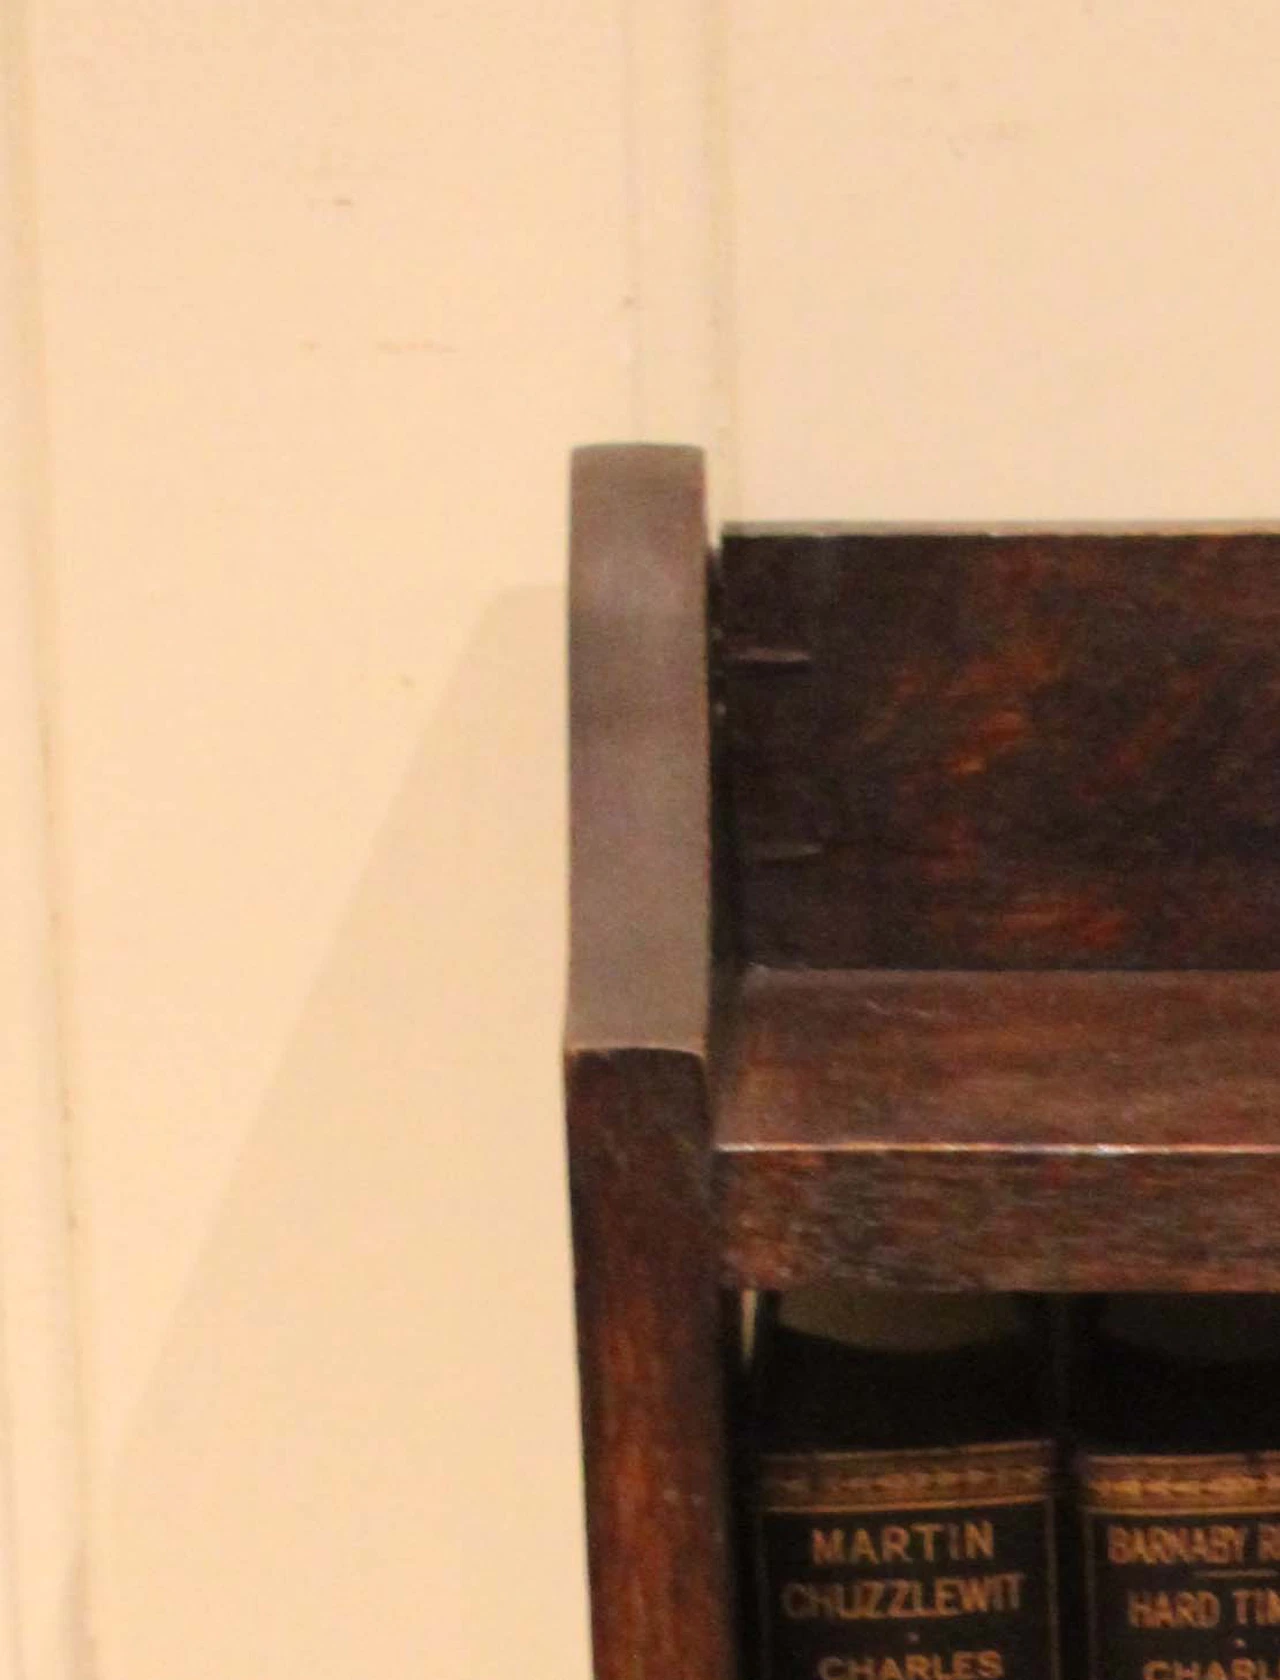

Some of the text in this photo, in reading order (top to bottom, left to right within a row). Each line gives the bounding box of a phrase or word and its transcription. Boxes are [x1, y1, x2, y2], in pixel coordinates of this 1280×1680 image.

[811, 1520, 994, 1565] MARTIN
[1106, 1523, 1246, 1565] BARNABY
[781, 1572, 1024, 1620] CHUZZLEWIT
[1127, 1591, 1221, 1629] HARD
